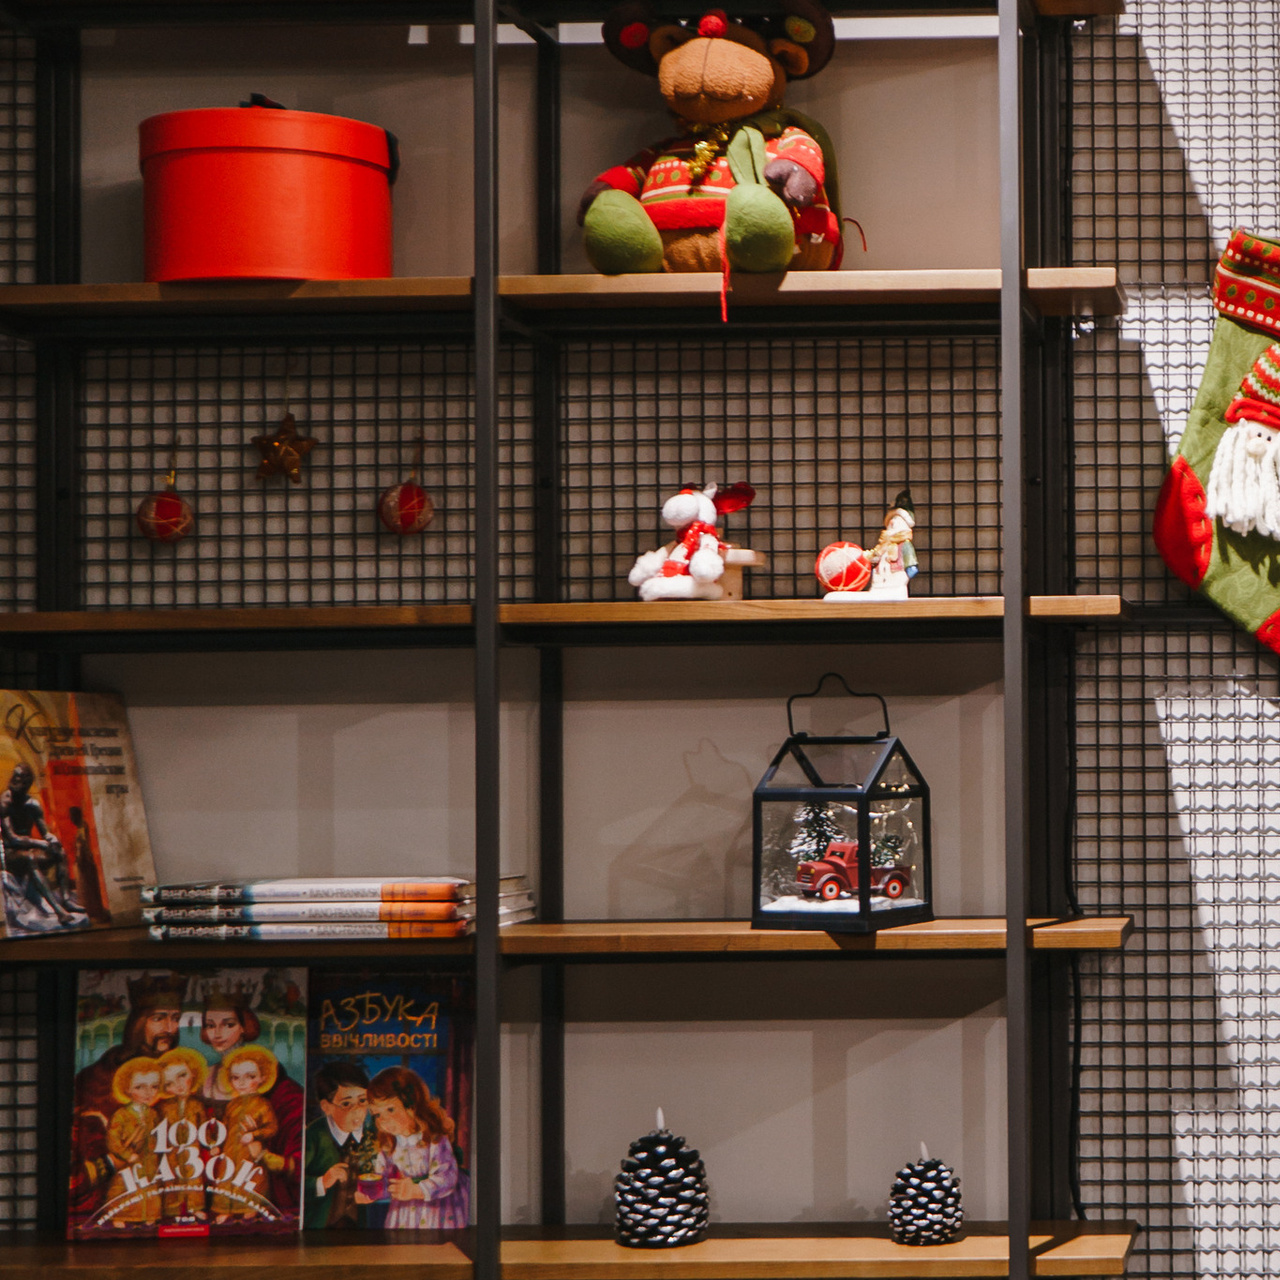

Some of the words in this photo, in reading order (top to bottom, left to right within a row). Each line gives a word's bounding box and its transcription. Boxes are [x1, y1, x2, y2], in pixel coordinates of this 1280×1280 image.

[320, 990, 439, 1032] АЗБУКА
[321, 1033, 437, 1048] ВВІЧЛИВОСТІ
[150, 1117, 227, 1153] 100
[118, 1145, 263, 1194] КАЗОК
